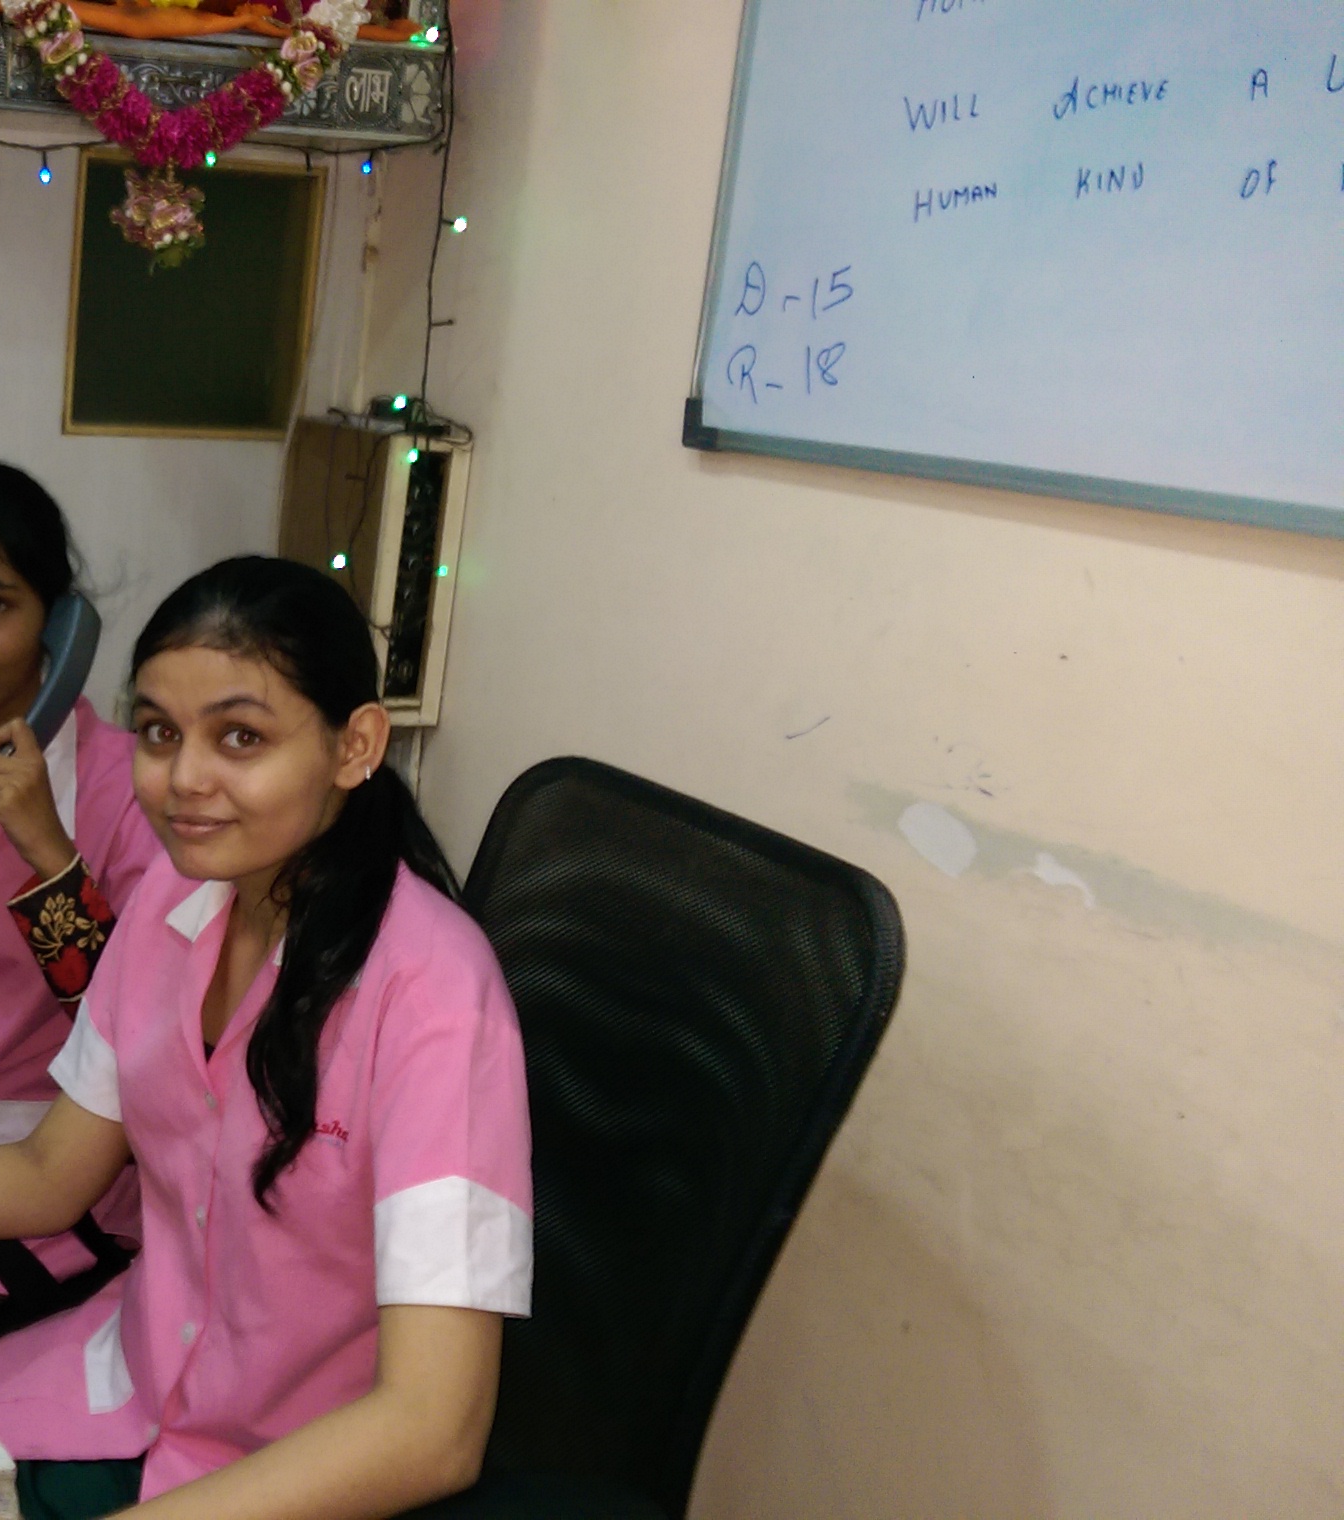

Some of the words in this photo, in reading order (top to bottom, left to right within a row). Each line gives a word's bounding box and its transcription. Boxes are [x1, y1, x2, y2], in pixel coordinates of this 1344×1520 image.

[344, 67, 392, 113] लाभ
[903, 94, 980, 131] WILL
[1052, 76, 1169, 120] ACHIEVE
[1250, 68, 1270, 101] A
[913, 182, 998, 223] HUMAN
[1239, 159, 1278, 200] OF
